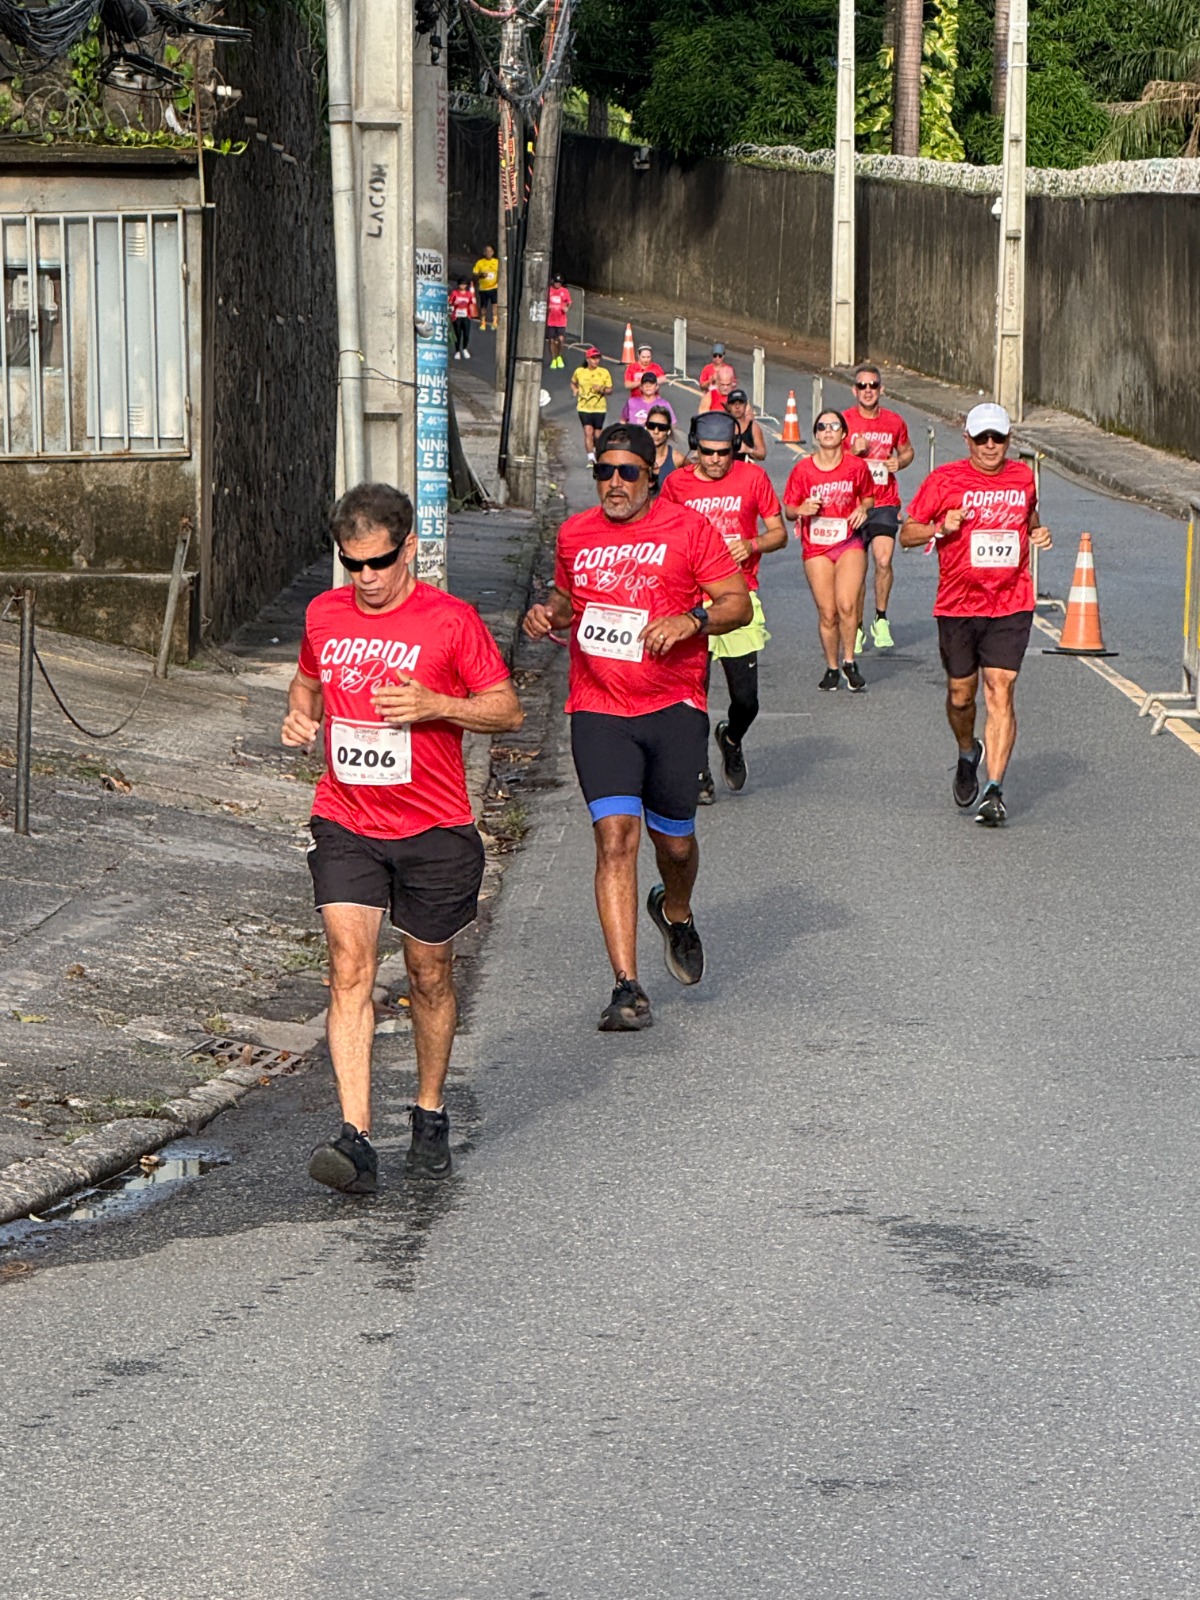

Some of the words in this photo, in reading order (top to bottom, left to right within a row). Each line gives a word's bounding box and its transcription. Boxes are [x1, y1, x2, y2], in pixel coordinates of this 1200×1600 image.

[962, 489, 1026, 508] CORRIDA
[813, 528, 839, 538] 0857
[573, 542, 667, 572] CORRIDA
[977, 545, 1013, 557] 0197
[574, 573, 588, 587] DO
[602, 557, 661, 603] Pepe
[584, 624, 633, 646] 0260
[320, 637, 422, 672] CORRIDA
[337, 746, 396, 768] 0206
